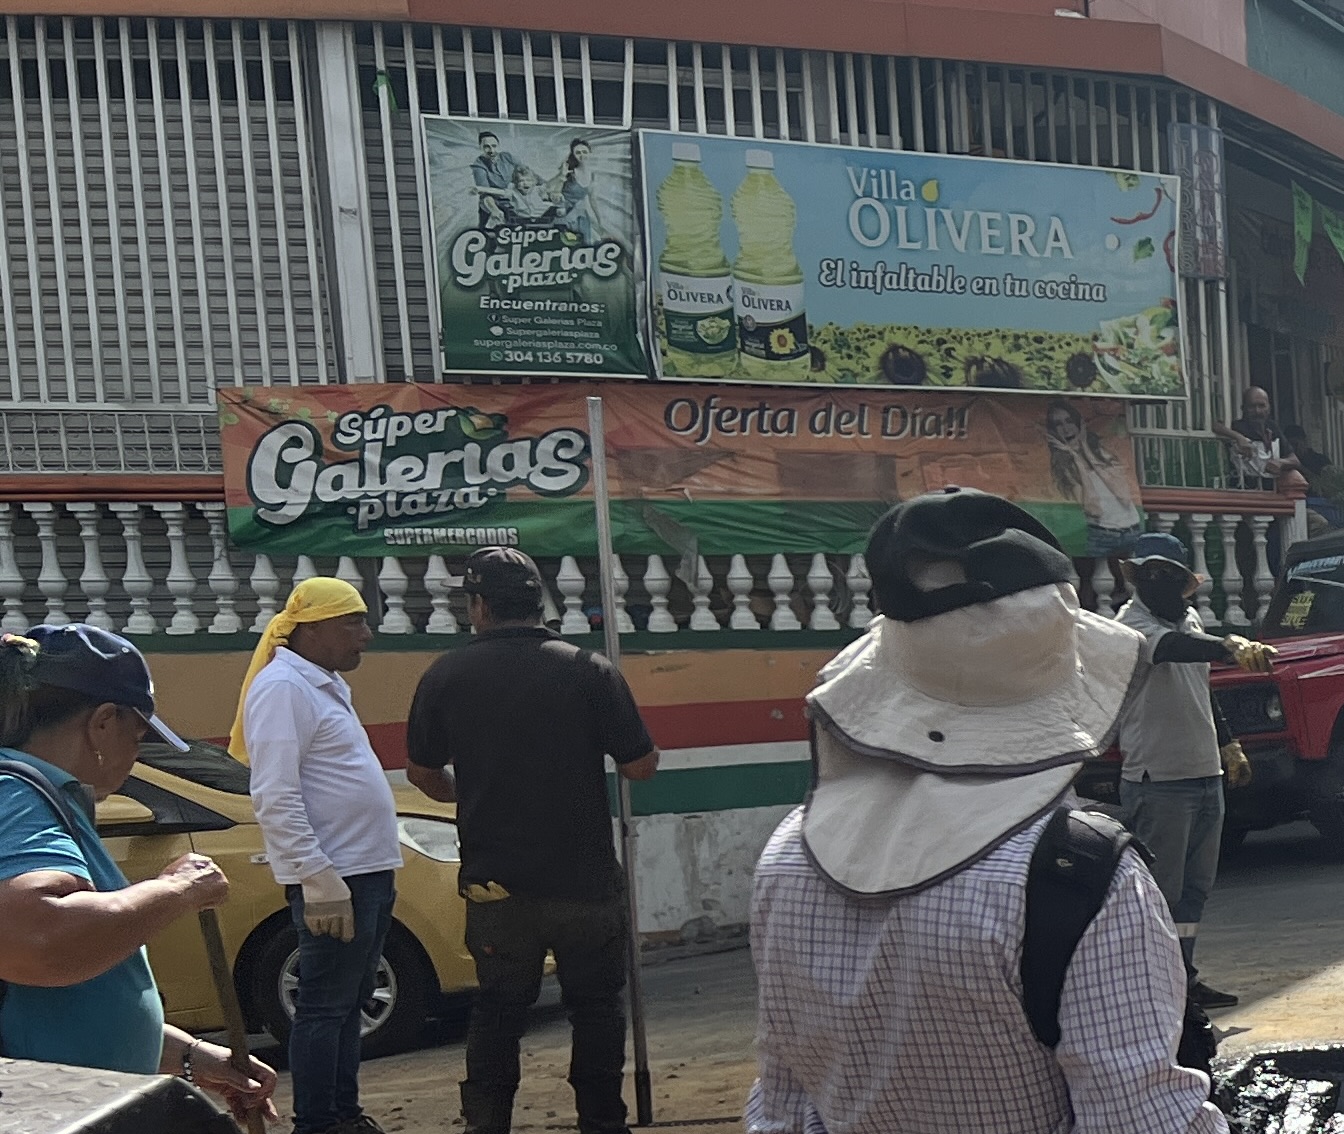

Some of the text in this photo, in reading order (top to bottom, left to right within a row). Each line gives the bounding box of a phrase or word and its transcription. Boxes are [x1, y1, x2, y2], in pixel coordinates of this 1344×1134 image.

[847, 166, 915, 201] Villa
[497, 226, 560, 246] Súper
[848, 197, 1074, 259] OLIVERA
[820, 259, 1107, 302] El infaltable en tu cocina
[479, 296, 605, 313] Encuentranos:
[667, 289, 724, 304] OLIVERA
[741, 295, 792, 312] OLIVERA
[502, 315, 531, 325] Super
[577, 318, 603, 328] Plaza
[474, 338, 618, 351] supergaleriasplaza.com.co
[505, 351, 603, 364] 304 136 5780
[336, 407, 456, 447] Súper
[664, 394, 798, 446] Oferta
[808, 402, 871, 439] del
